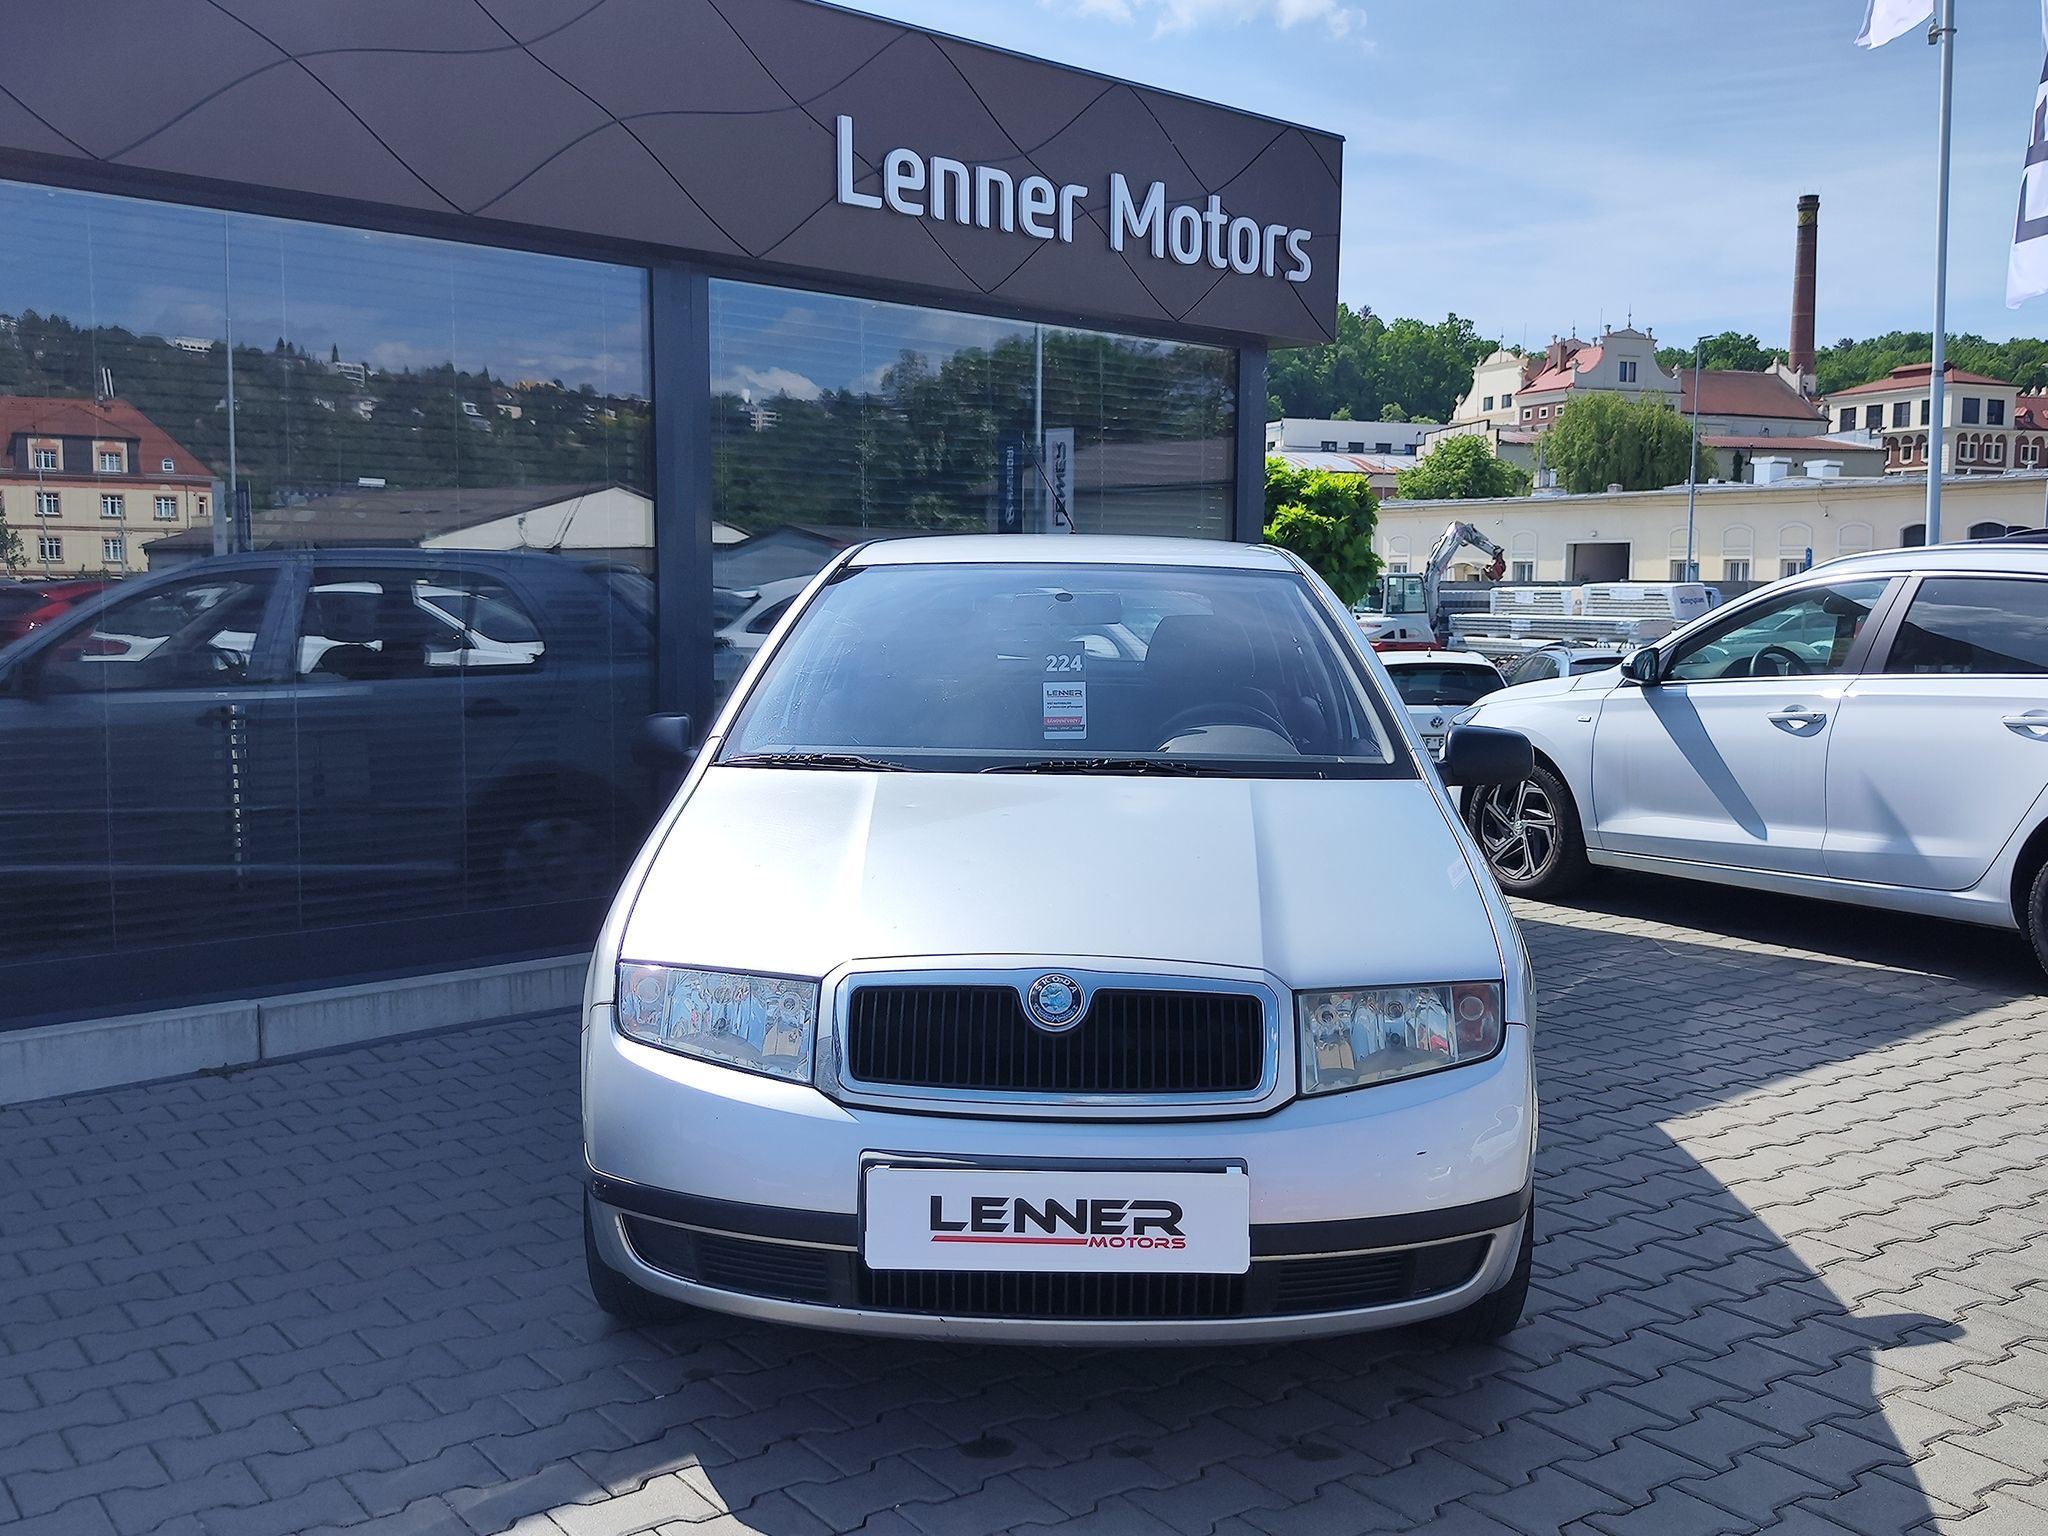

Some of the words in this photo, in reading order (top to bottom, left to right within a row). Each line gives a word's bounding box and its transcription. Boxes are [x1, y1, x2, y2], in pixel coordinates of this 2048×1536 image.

[836, 113, 1088, 244] Lenner
[1110, 172, 1312, 283] Motors
[1045, 654, 1083, 672] 224
[929, 1195, 1187, 1236] LENNER
[1087, 1237, 1187, 1250] MOTORS
